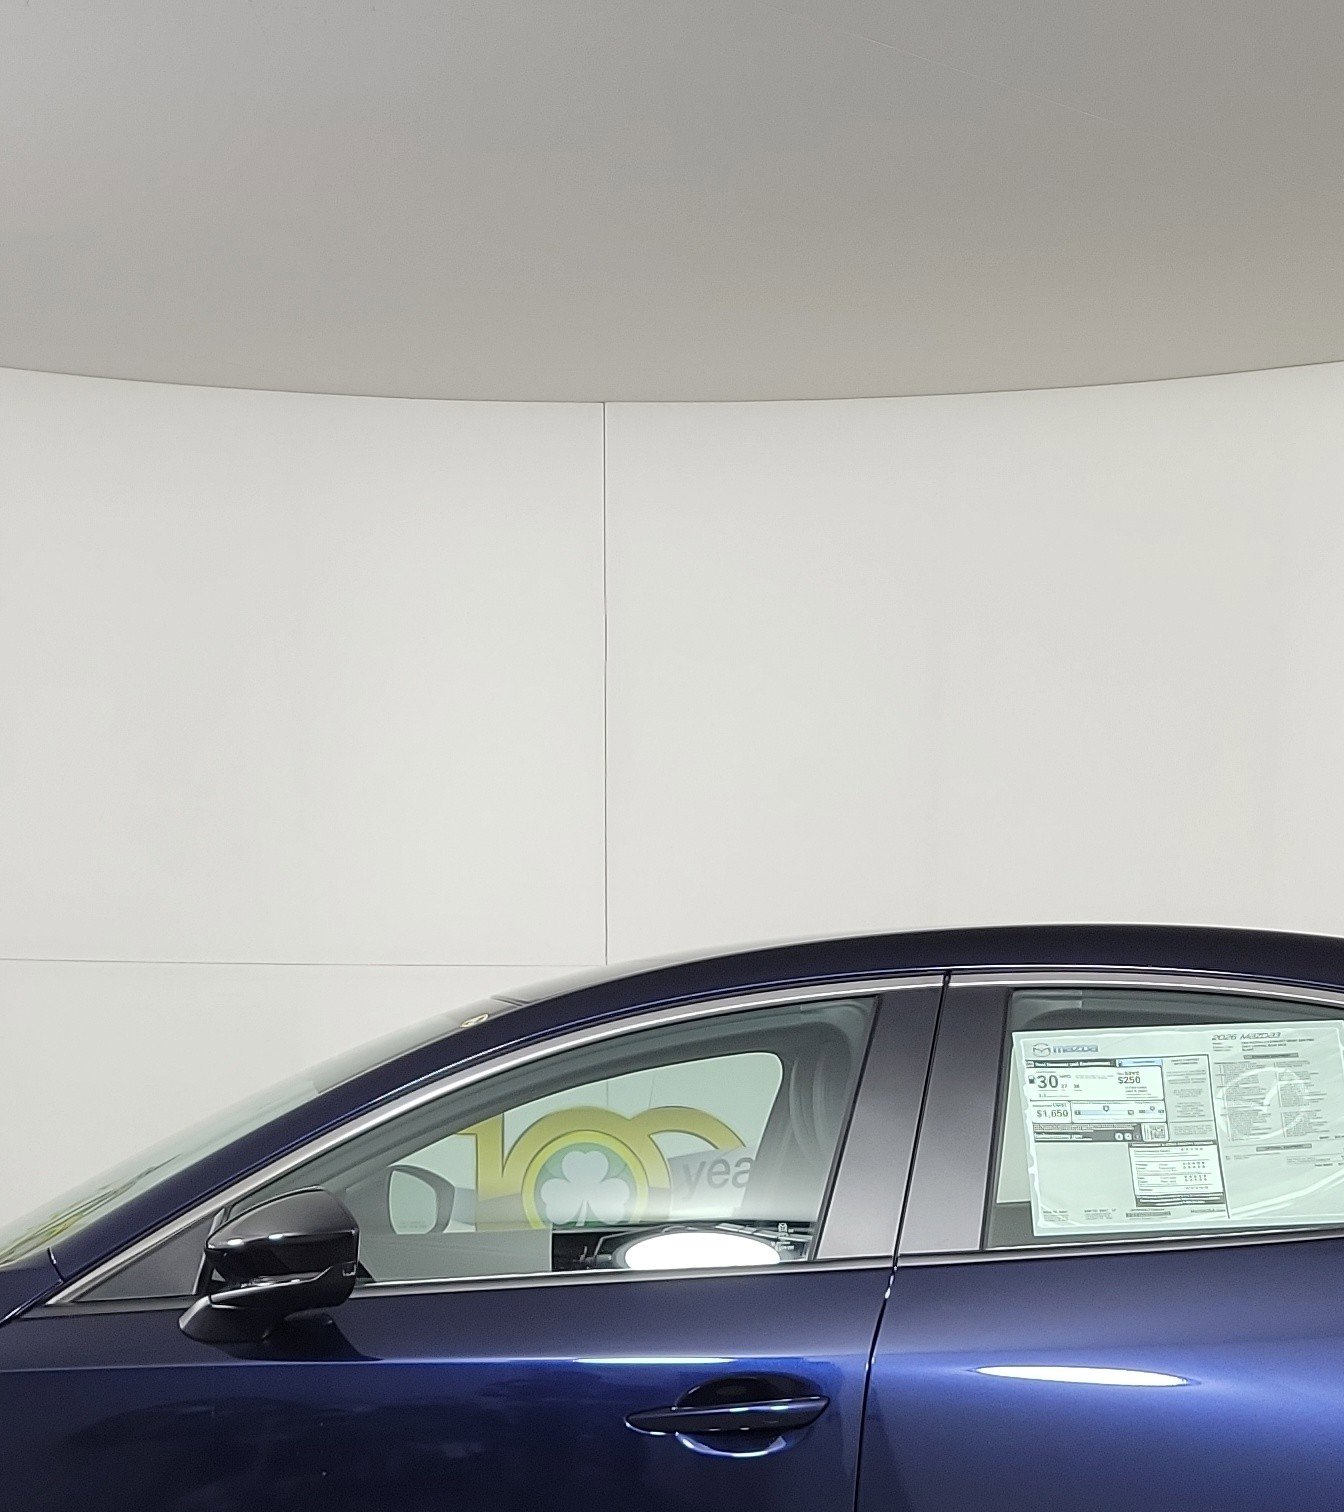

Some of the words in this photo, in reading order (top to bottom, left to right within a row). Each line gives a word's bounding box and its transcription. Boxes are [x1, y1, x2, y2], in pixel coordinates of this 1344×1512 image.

[1036, 1074, 1059, 1089] 30
[1117, 1076, 1141, 1084] $250
[681, 1156, 752, 1195] yea
